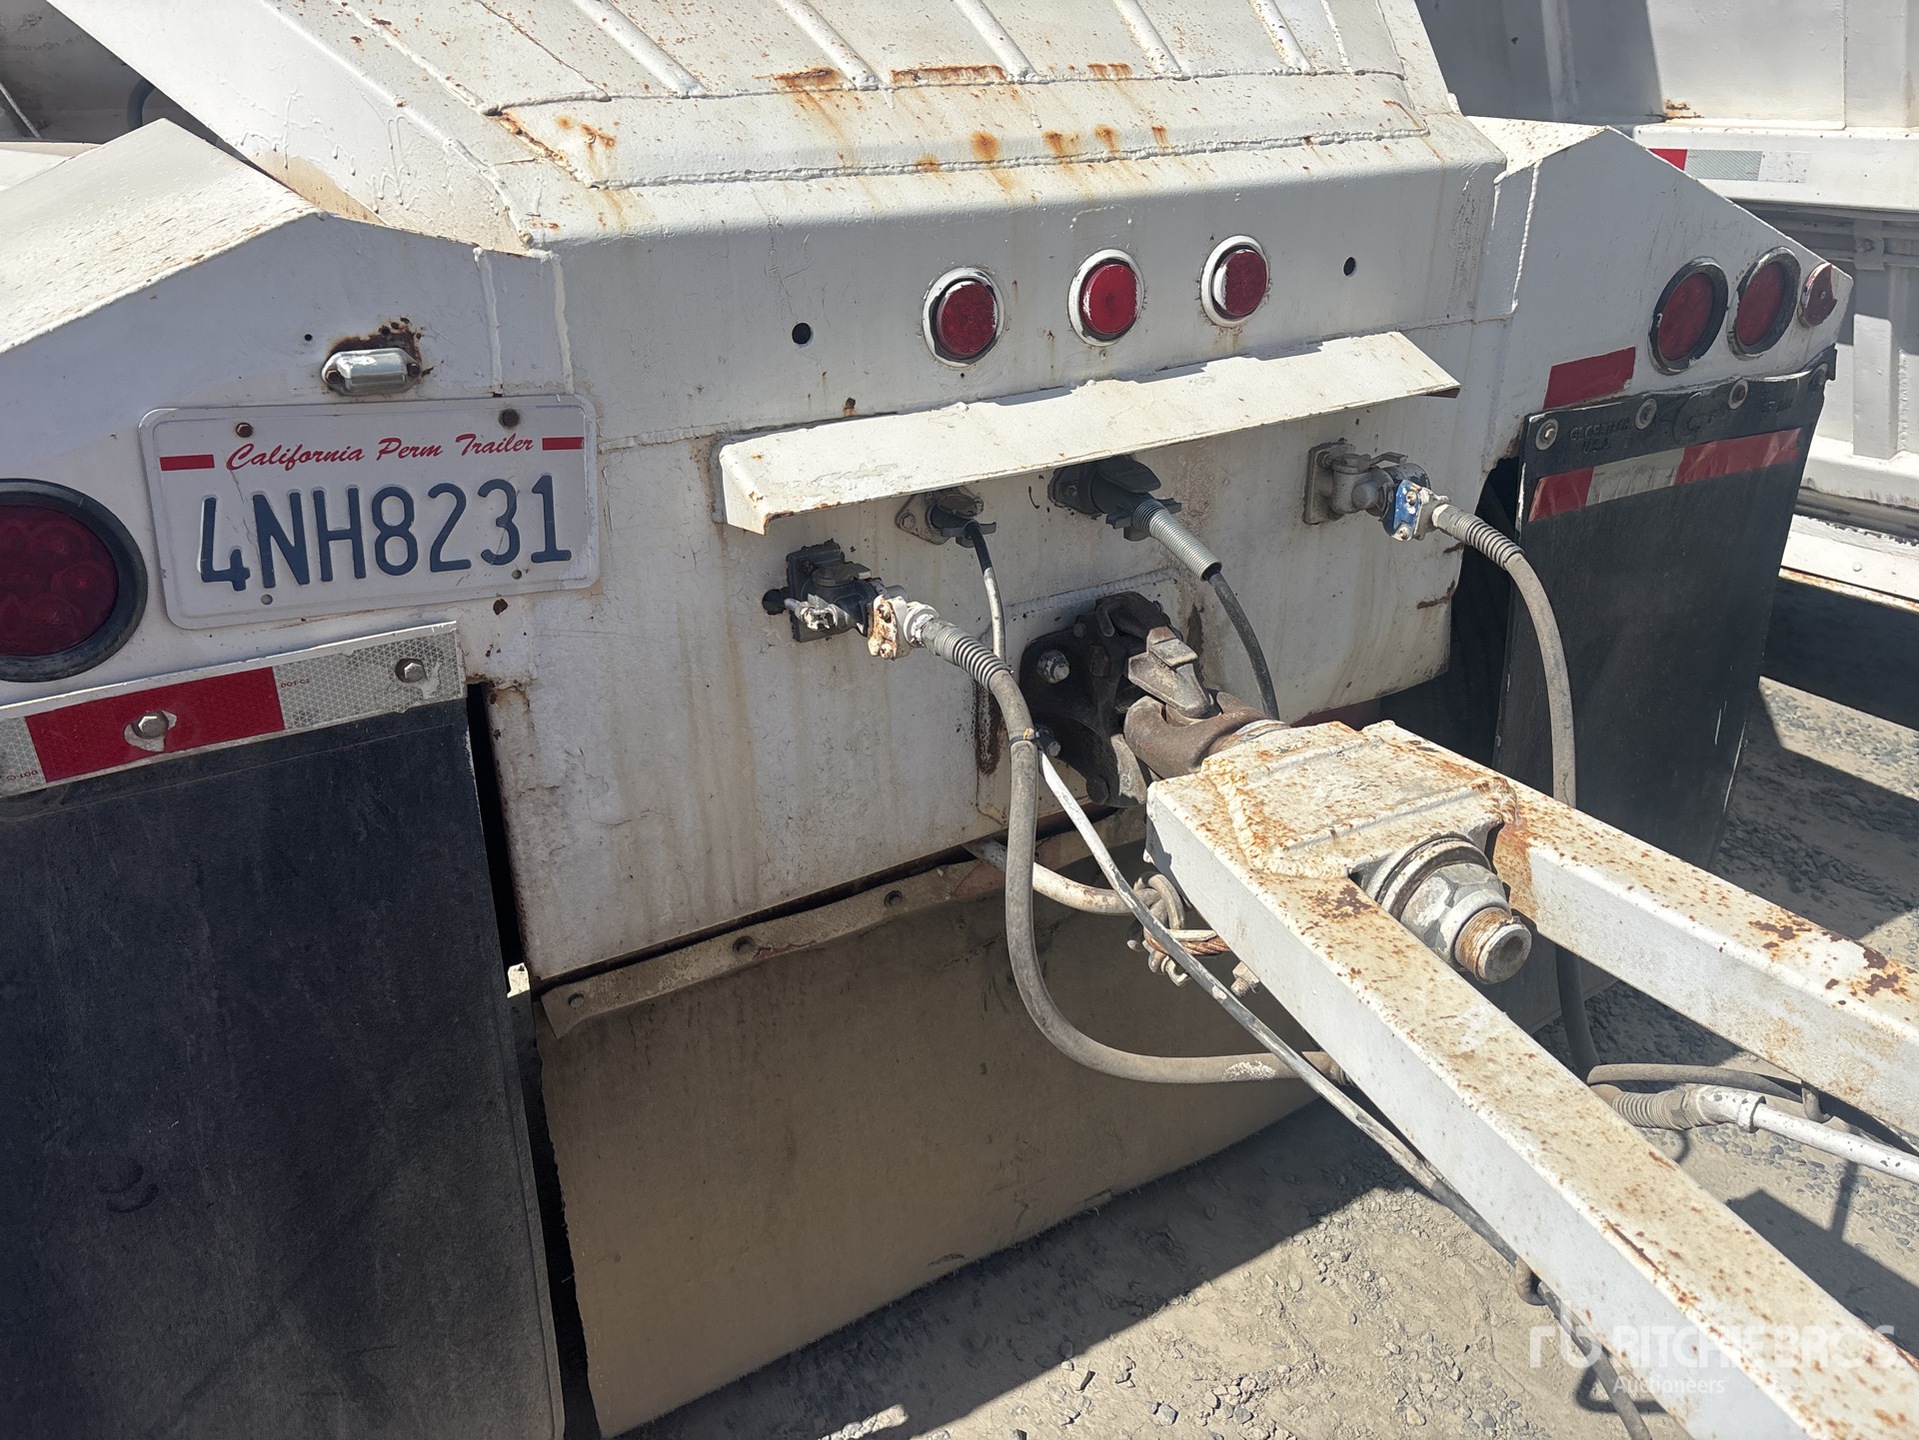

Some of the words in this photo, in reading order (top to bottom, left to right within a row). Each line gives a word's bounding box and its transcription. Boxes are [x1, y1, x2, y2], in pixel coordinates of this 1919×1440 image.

[226, 443, 365, 472] California
[376, 437, 443, 461] Perm
[455, 433, 534, 456] Trailer
[200, 474, 573, 592] 4NH8231
